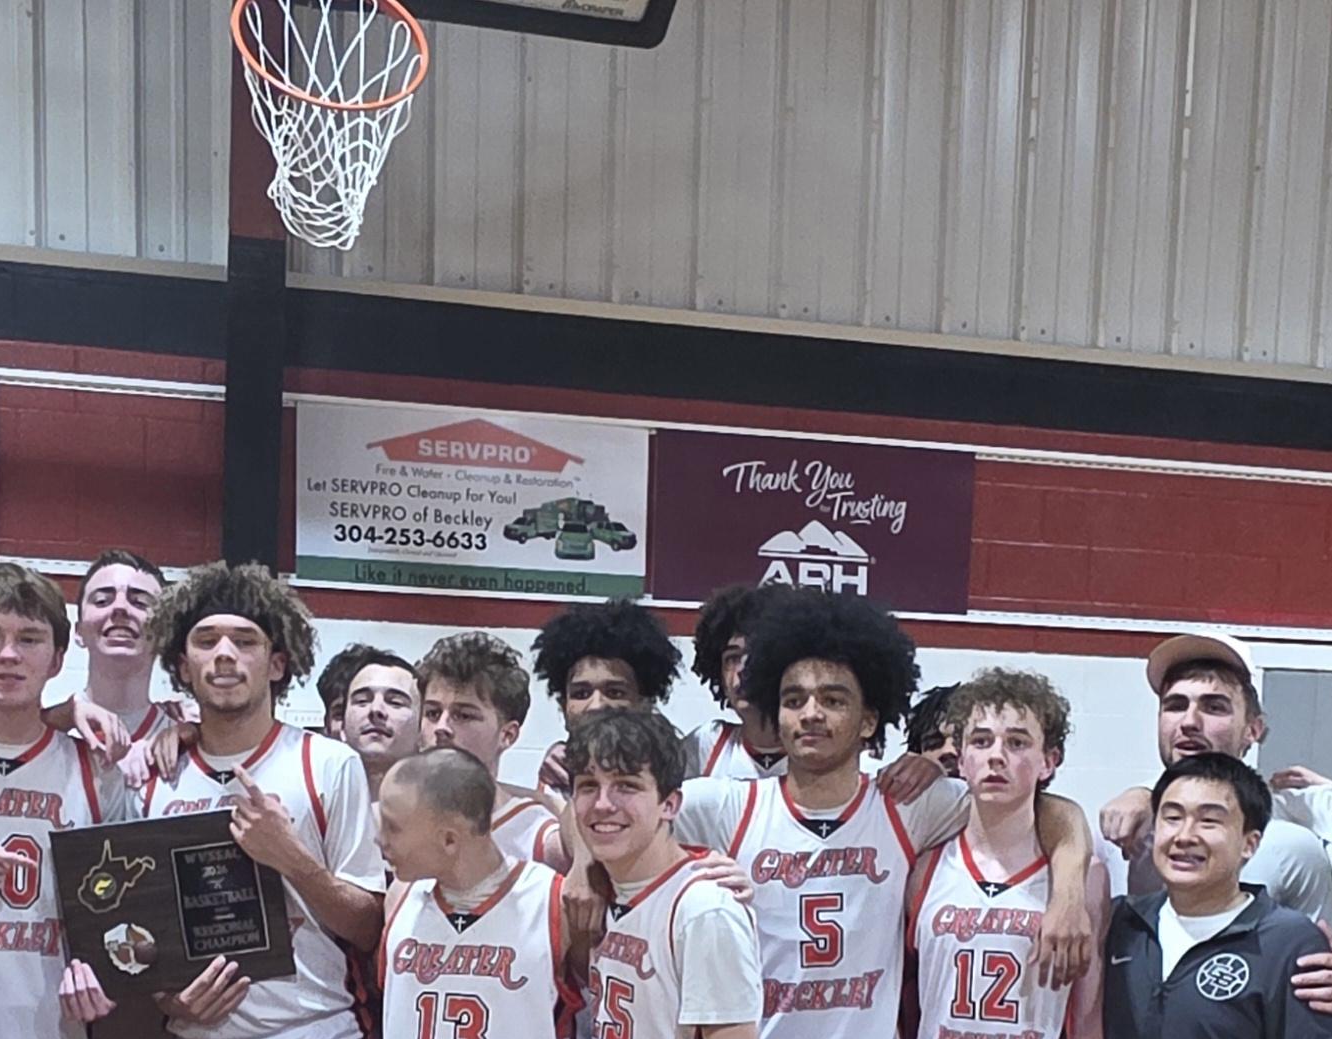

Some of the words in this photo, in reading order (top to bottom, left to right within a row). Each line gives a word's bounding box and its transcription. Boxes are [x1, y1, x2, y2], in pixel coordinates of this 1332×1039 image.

[418, 437, 531, 464] SERVPRO
[307, 477, 327, 492] Let
[331, 479, 402, 498] SERVPRO
[407, 485, 462, 504] Cleanup
[466, 488, 485, 502] for
[488, 489, 517, 505] You!
[375, 463, 396, 477] Fire
[410, 466, 444, 480] Water
[454, 469, 502, 486] Cleanup
[722, 459, 803, 494] Thank
[804, 460, 855, 508] You
[328, 502, 407, 522] SERVPRO
[412, 509, 430, 523] of
[434, 510, 493, 531] Beckley
[826, 490, 907, 535] Trusting
[333, 523, 488, 551] 304-253-6633
[354, 563, 387, 583] Like
[392, 566, 404, 584] it
[407, 571, 456, 587] never
[459, 575, 498, 591] even
[752, 846, 891, 889] GREATER
[799, 892, 844, 969] 5
[393, 937, 528, 991] GREATER
[763, 968, 885, 1020] BECKLEY
[950, 948, 1022, 1025] 12
